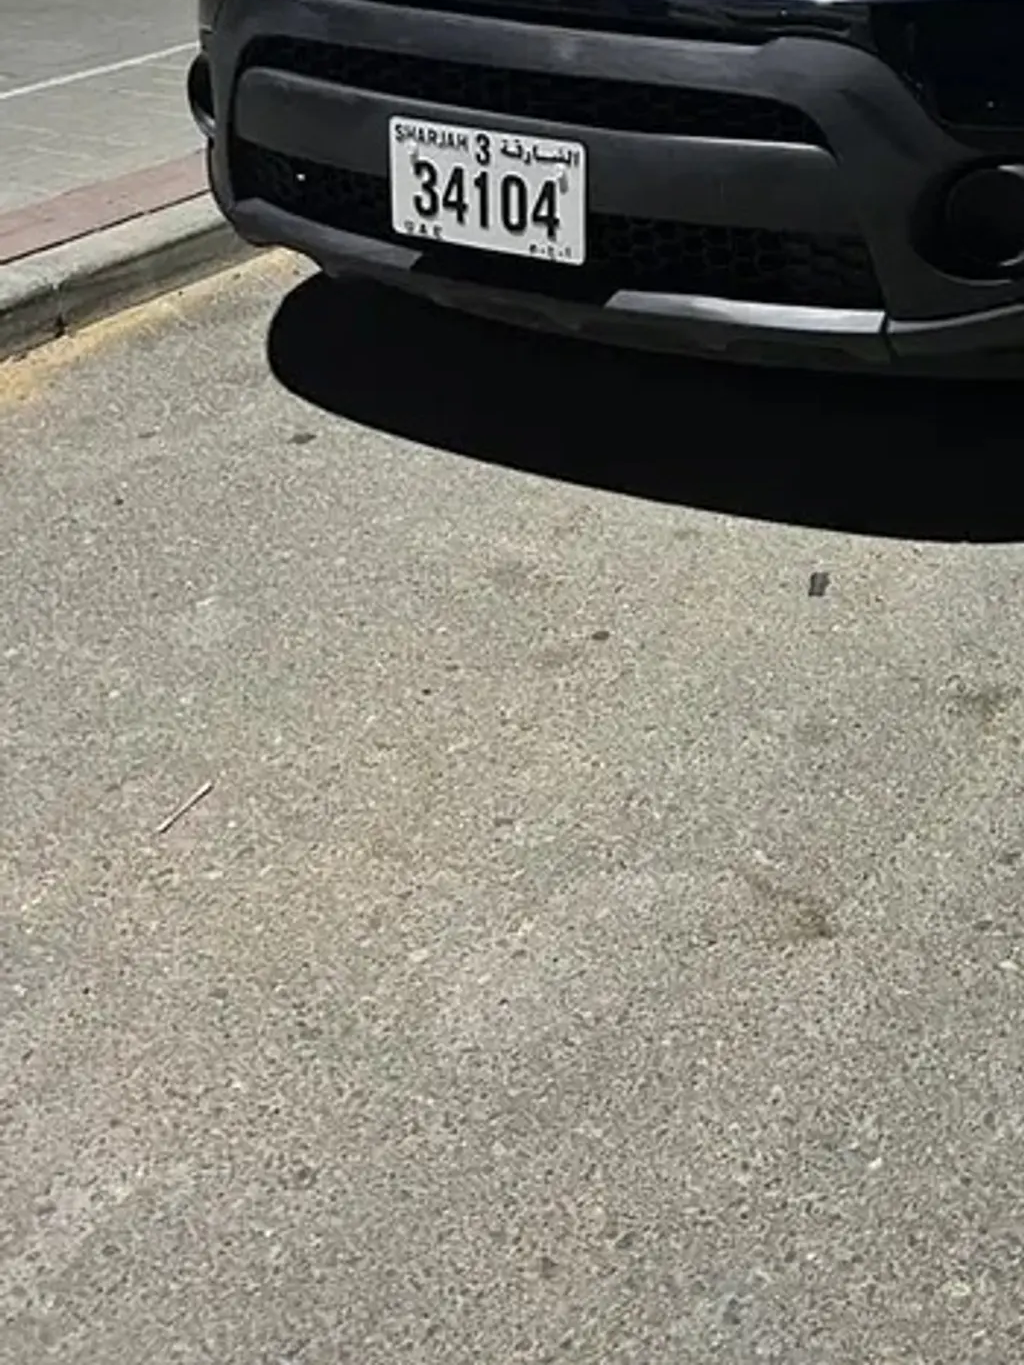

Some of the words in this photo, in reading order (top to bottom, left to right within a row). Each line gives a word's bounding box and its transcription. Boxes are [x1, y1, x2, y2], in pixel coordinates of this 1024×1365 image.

[395, 124, 469, 153] SHARJAH
[476, 133, 490, 166] 3
[413, 159, 560, 242] 34104
